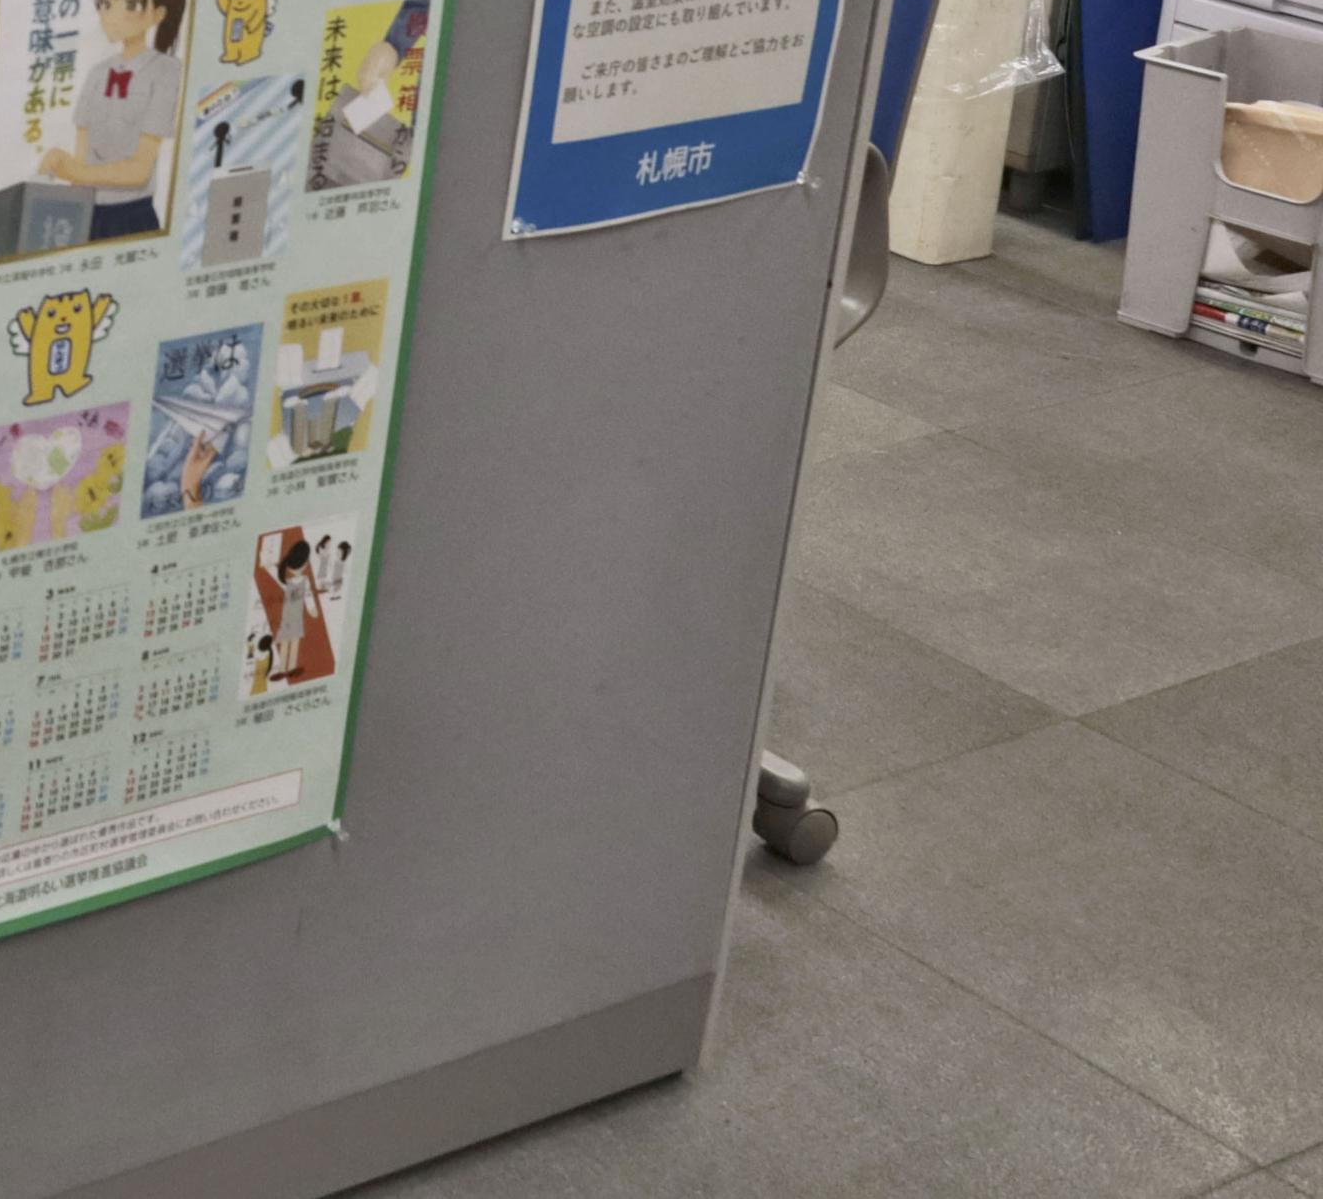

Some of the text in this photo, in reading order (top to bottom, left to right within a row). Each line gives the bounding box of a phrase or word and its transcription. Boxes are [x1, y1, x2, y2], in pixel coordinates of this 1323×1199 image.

[581, 34, 804, 80] ご来庁の皆さまのご理解とご協力をお
[310, 16, 347, 190] 未来は始まる
[563, 79, 638, 104] 願いします。
[636, 141, 716, 186] 札幌市
